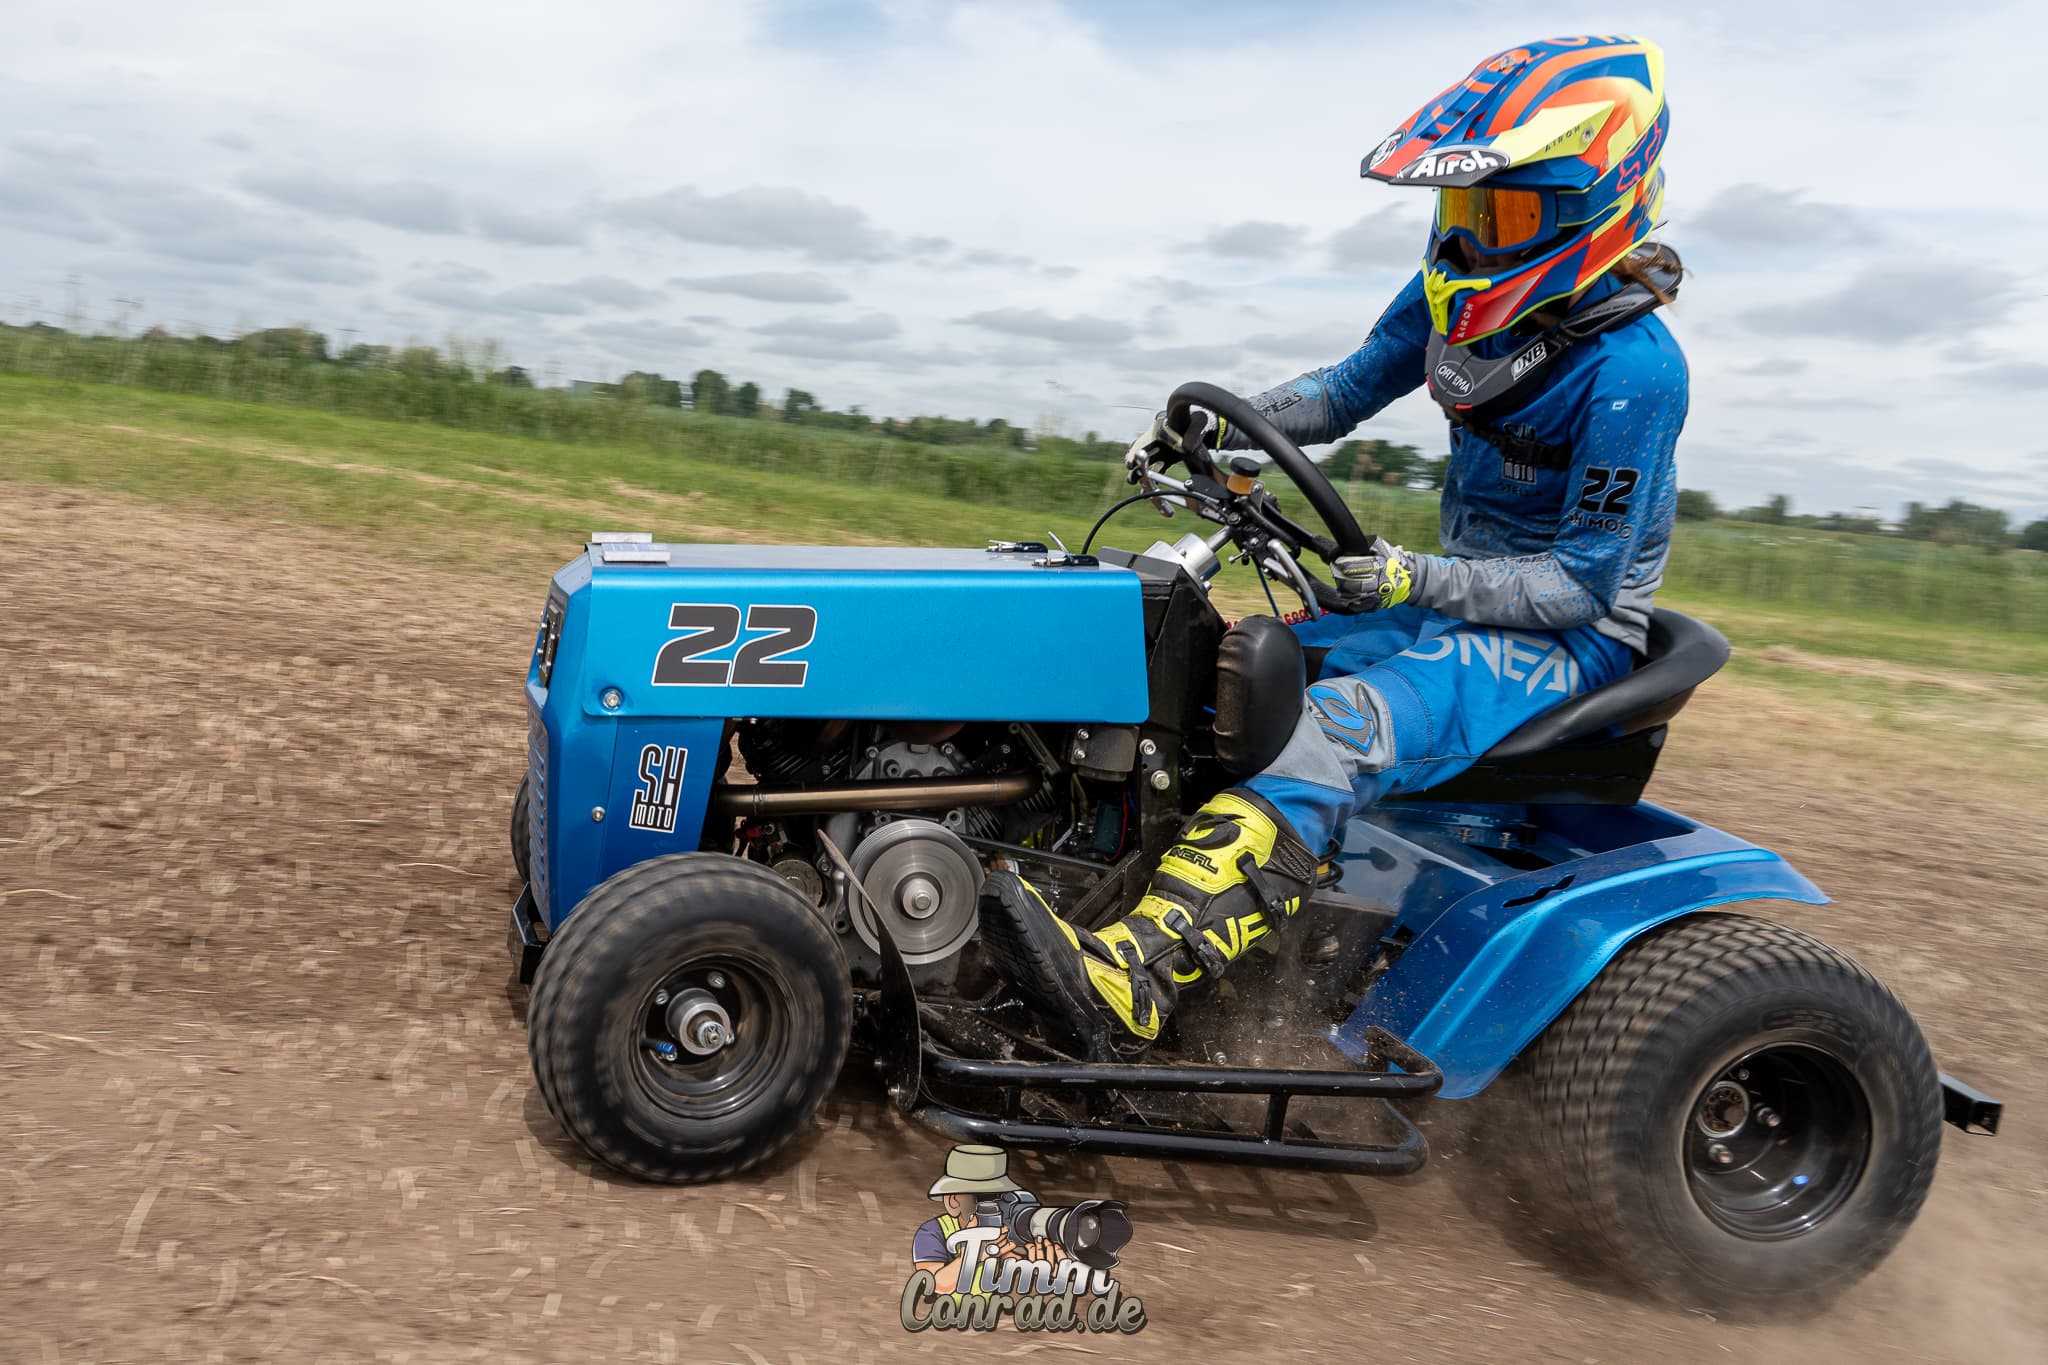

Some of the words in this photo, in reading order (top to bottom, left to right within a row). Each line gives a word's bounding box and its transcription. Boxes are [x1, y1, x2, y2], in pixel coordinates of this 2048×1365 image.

[1410, 150, 1499, 179] Airoh
[1576, 465, 1641, 516] 22
[651, 603, 818, 688] 22
[633, 743, 688, 806] SH
[634, 803, 674, 829] MOTO
